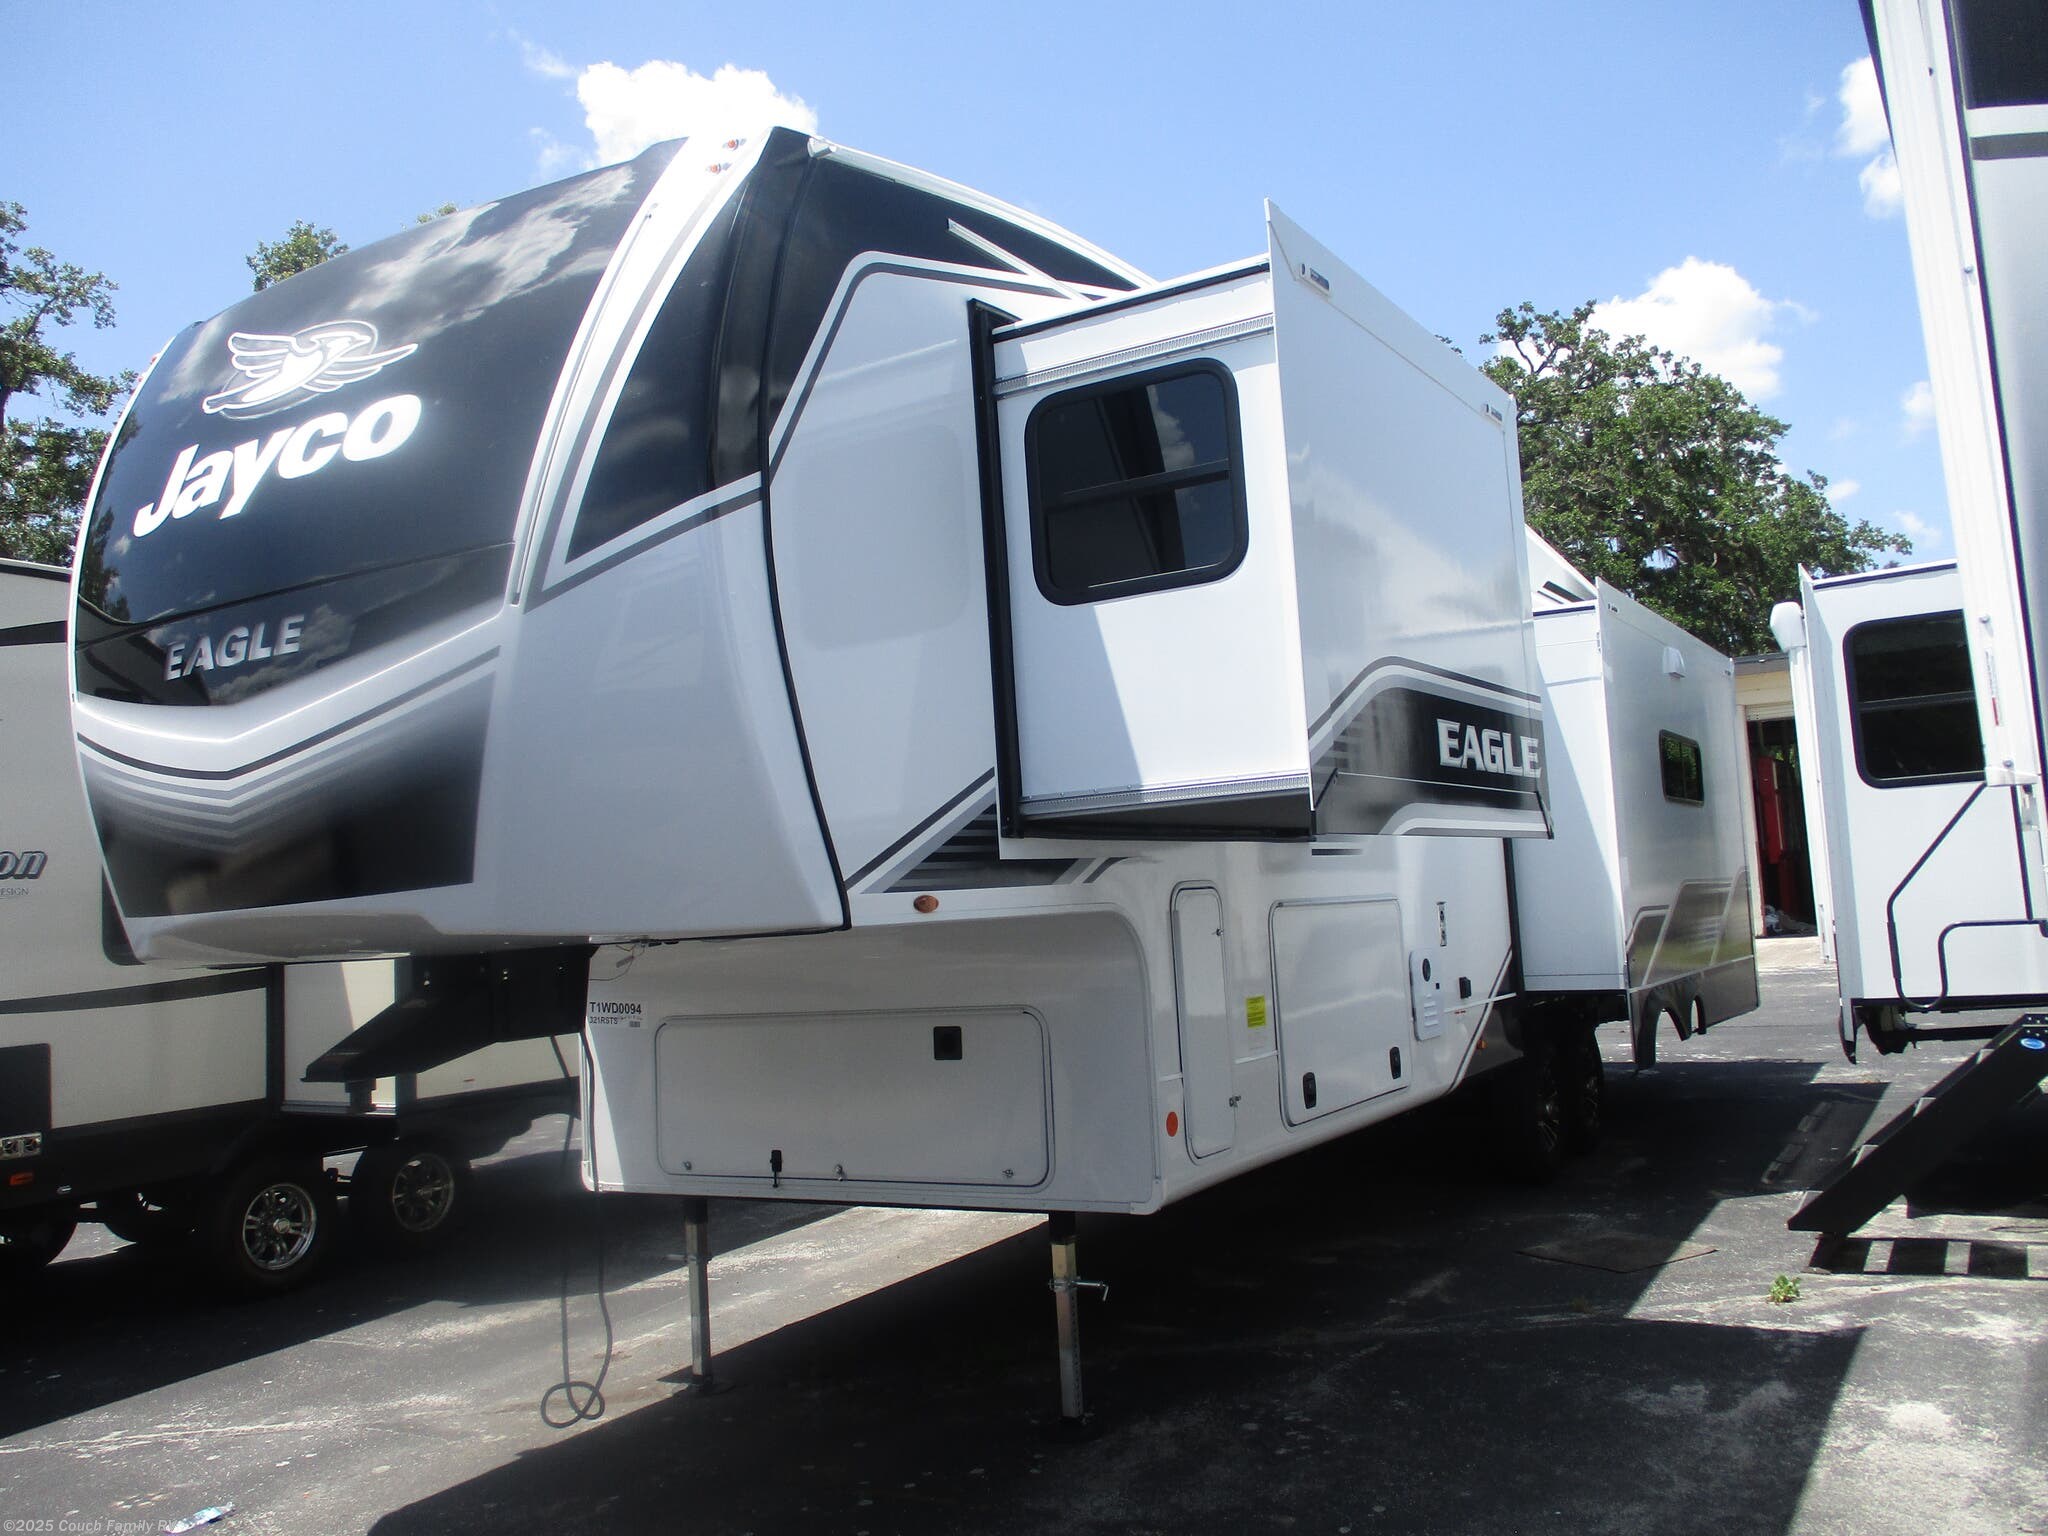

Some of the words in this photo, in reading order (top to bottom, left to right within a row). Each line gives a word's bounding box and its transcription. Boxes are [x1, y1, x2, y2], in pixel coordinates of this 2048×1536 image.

[133, 395, 422, 537] Jayco
[164, 614, 305, 681] EAGLE
[1436, 718, 1541, 778] EAGLE
[589, 1001, 642, 1014] T1WD0094
